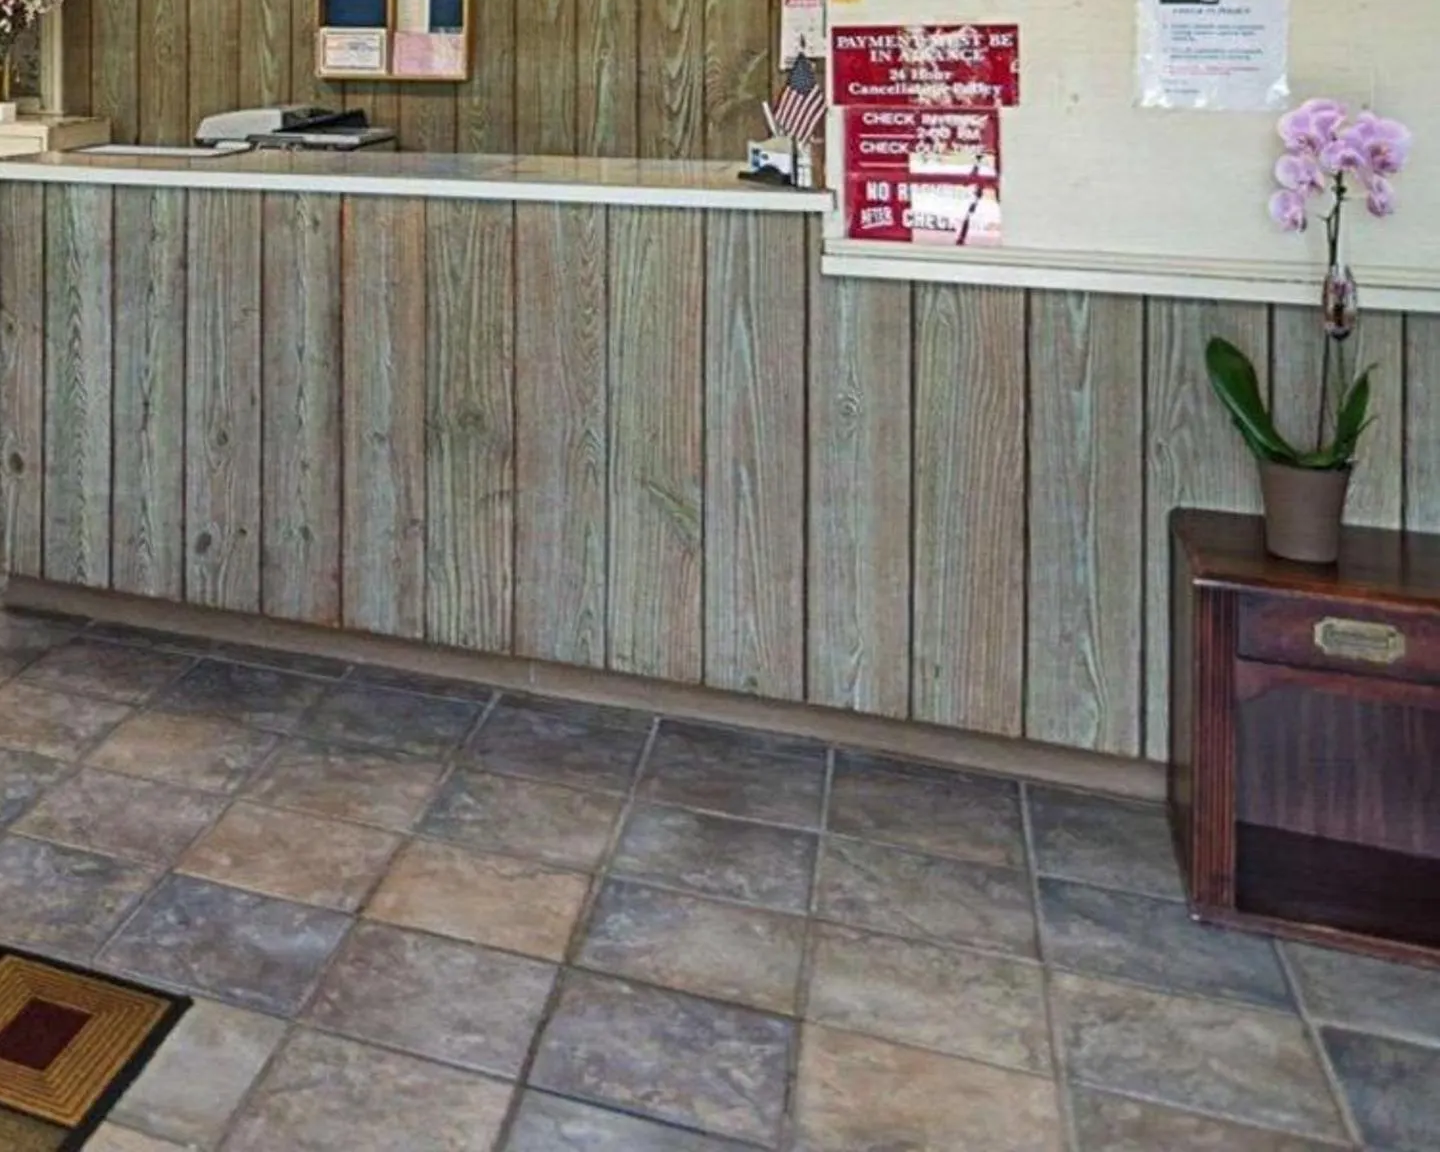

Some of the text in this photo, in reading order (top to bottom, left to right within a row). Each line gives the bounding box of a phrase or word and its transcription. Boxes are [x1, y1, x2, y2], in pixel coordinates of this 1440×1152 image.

[930, 35, 982, 47] MST
[989, 34, 1014, 47] BE
[870, 49, 986, 63] IN AANCE
[848, 83, 950, 96] Cancella
[863, 111, 916, 126] CHECK
[859, 140, 910, 154] CHECK
[866, 180, 892, 202] NO
